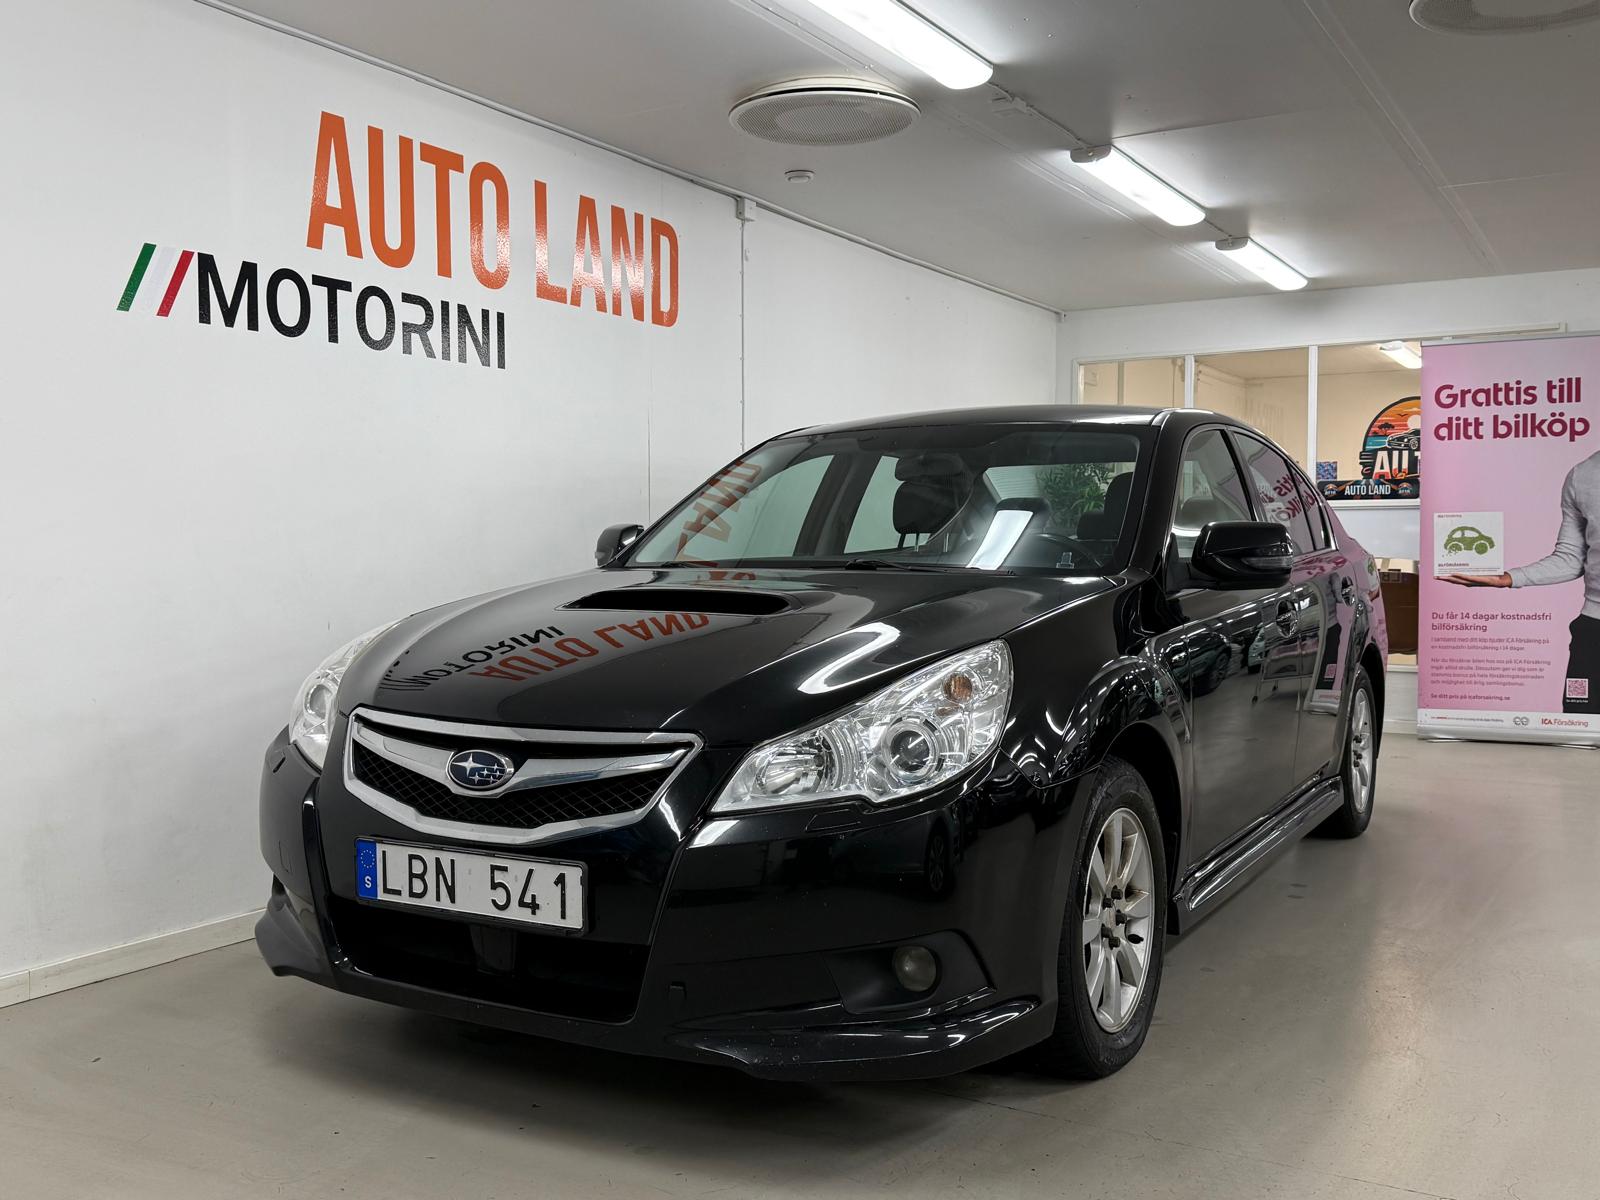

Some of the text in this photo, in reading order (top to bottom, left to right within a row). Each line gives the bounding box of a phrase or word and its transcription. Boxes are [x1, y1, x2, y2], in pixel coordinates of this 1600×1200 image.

[306, 111, 679, 328] AUTO LAND
[197, 252, 506, 370] MOTORINI
[1434, 377, 1582, 409] Grattis till
[1433, 412, 1590, 442] ditt bilköp
[1344, 484, 1391, 496] AUTO LAND
[1431, 611, 1552, 622] Du får 14 dagar kostnadsfri
[1431, 622, 1488, 633] bilförsäkring
[1553, 718, 1589, 728] Försäkring
[364, 875, 372, 889] S
[381, 850, 567, 920] LBN 541
